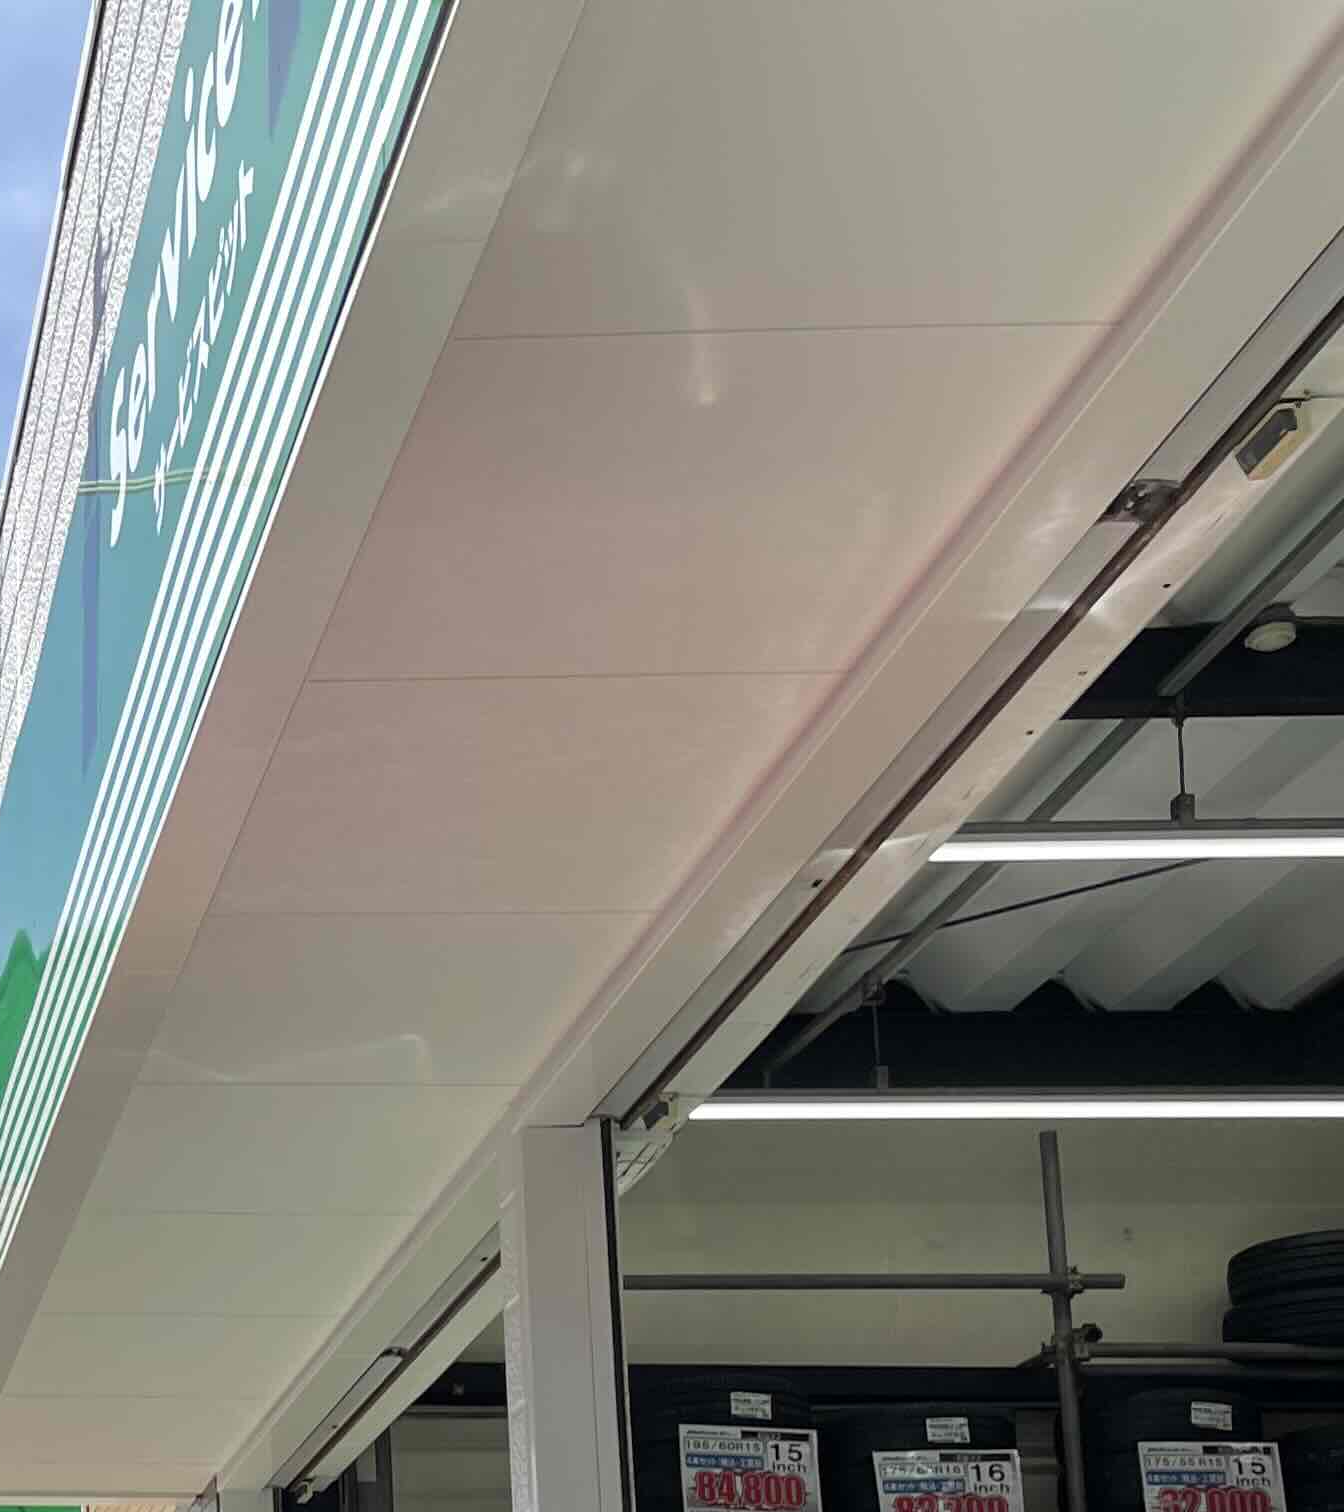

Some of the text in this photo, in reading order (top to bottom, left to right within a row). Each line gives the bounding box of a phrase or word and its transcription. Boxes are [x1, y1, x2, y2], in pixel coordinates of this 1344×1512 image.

[771, 1443, 803, 1462] 15
[772, 1462, 808, 1473] inch
[970, 1464, 1005, 1483] 16
[1233, 1458, 1266, 1475] 15
[973, 1483, 1010, 1494] inch
[1236, 1477, 1272, 1488] inch
